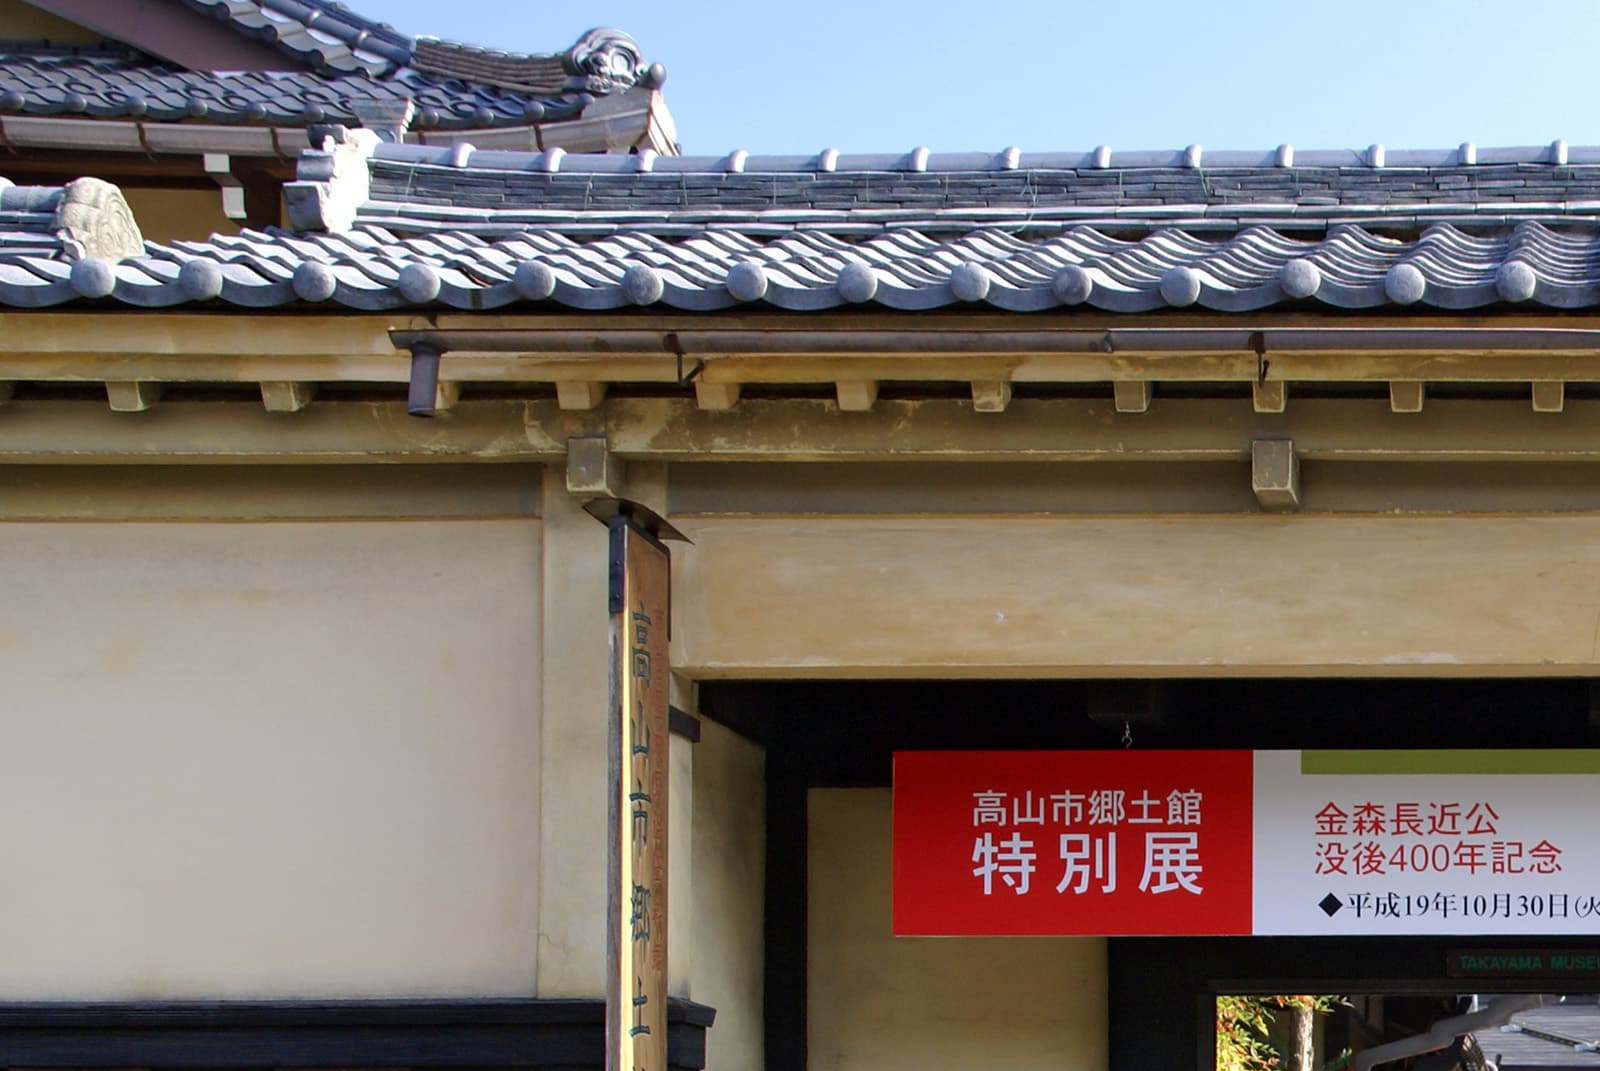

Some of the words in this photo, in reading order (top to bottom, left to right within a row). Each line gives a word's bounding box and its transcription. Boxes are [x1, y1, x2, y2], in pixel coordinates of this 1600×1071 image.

[972, 790, 1203, 826] 高山市郷土館
[1314, 802, 1499, 836] 金森長近公
[971, 832, 1204, 895] 特別展
[1314, 840, 1563, 876] 没後400年記念
[1458, 956, 1543, 970] TAKAYAMA
